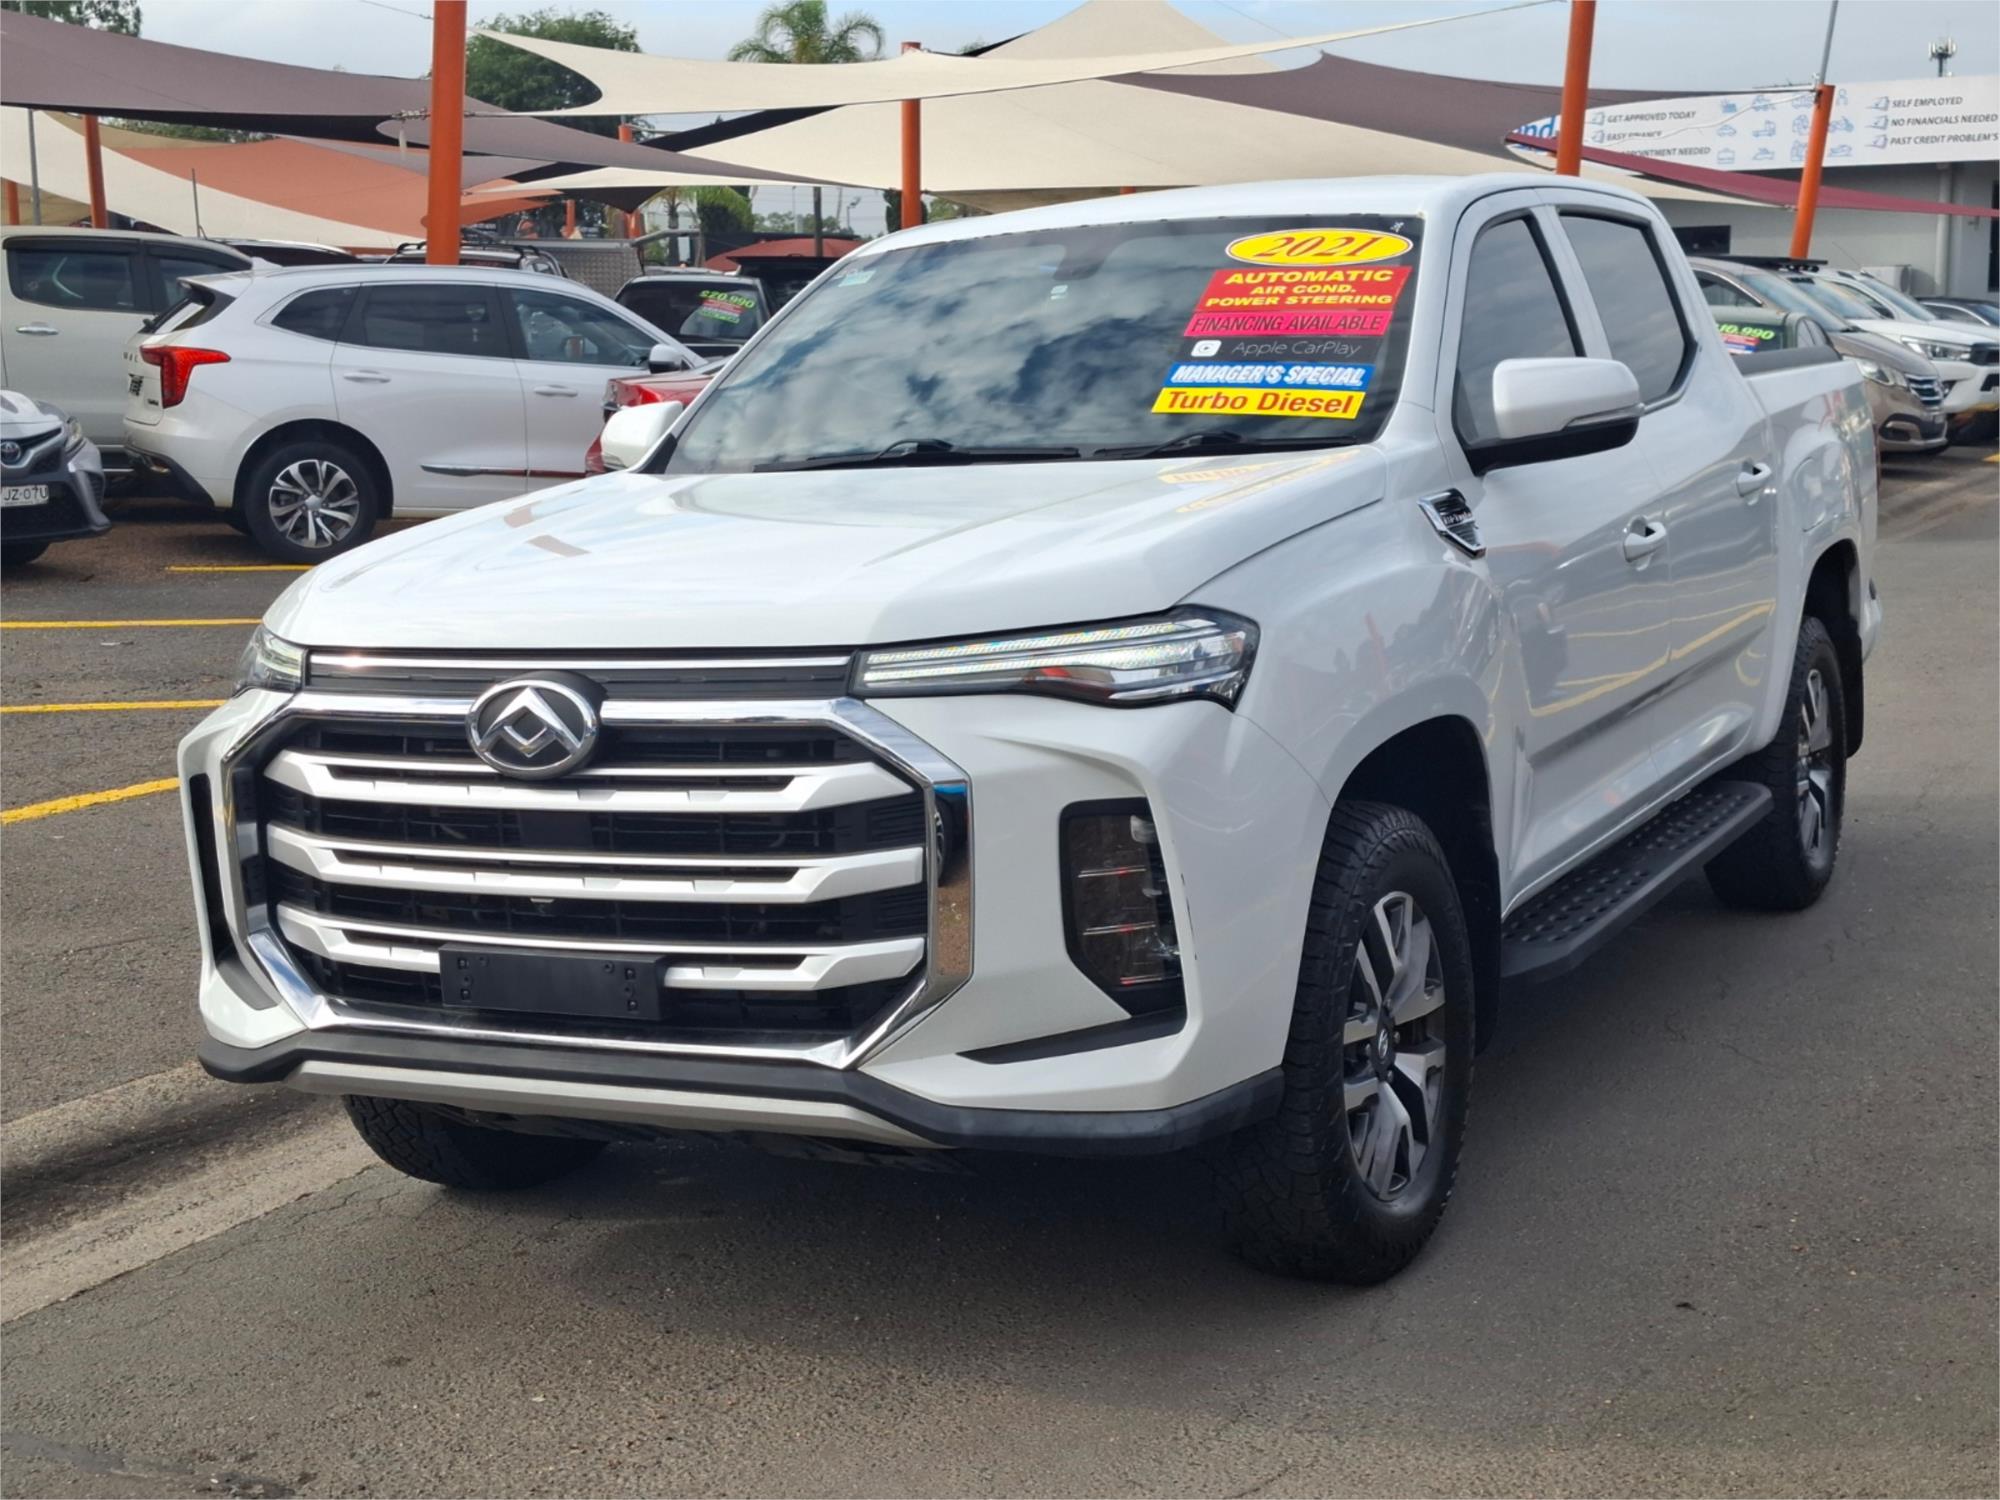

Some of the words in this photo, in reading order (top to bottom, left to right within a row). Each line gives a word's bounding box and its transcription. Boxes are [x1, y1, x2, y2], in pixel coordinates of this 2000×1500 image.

[1892, 99, 1912, 108] SELF
[1913, 96, 1963, 107] EMPLOYED
[1607, 114, 1624, 123] GET
[1624, 112, 1667, 121] APPROVED
[1669, 110, 1696, 119] TODAY
[1890, 118, 1905, 126] NO
[1906, 114, 1959, 125] FINANCIALS
[1961, 113, 1999, 123] NEEDED
[1890, 137, 1912, 145] PAST
[1913, 135, 1945, 144] CREDIT
[1946, 132, 1999, 143] PROBLEM'S
[1678, 146, 1712, 156] NEEDED
[1253, 236, 1383, 257] 2021
[1224, 270, 1394, 285] AUTOMATIC
[1249, 285, 1286, 296] AIR
[1292, 284, 1357, 294] COND.
[1205, 297, 1280, 308] POWER
[1284, 294, 1394, 306] STEERING
[1191, 317, 1284, 333] FINANCING
[1286, 315, 1383, 331] AVAILABLE
[1231, 342, 1288, 357] Apple
[1291, 340, 1362, 358] CarPlay
[1171, 365, 1285, 383] MANAGER'S
[1284, 366, 1365, 386] SPECIAL
[1167, 391, 1250, 410] Turbo
[1257, 392, 1354, 414] Diesel
